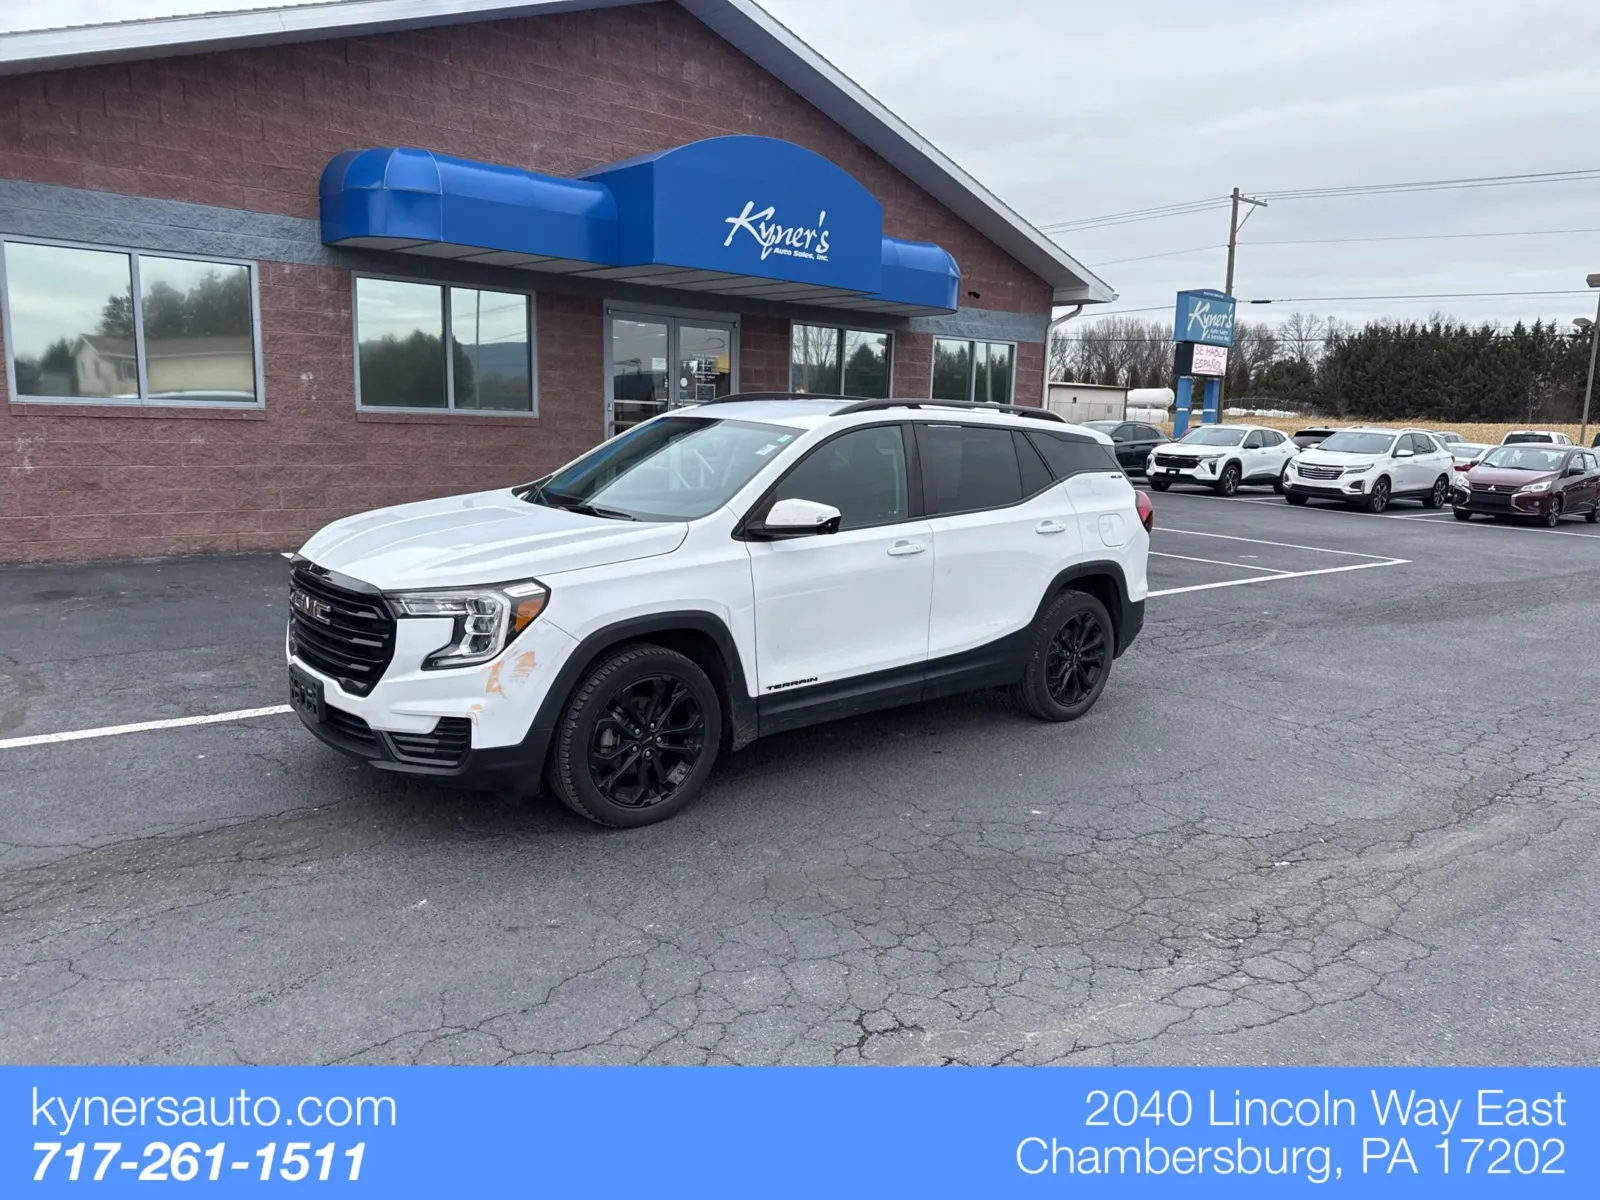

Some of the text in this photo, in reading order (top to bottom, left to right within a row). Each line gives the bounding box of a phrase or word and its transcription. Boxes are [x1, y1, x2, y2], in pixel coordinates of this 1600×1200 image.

[724, 201, 829, 260] Kyner's
[773, 247, 792, 256] Auto
[1187, 301, 1233, 340] Kyner's
[1195, 345, 1226, 358] SE HABLA
[294, 591, 331, 625] GMC
[766, 677, 818, 690] TERRAIN
